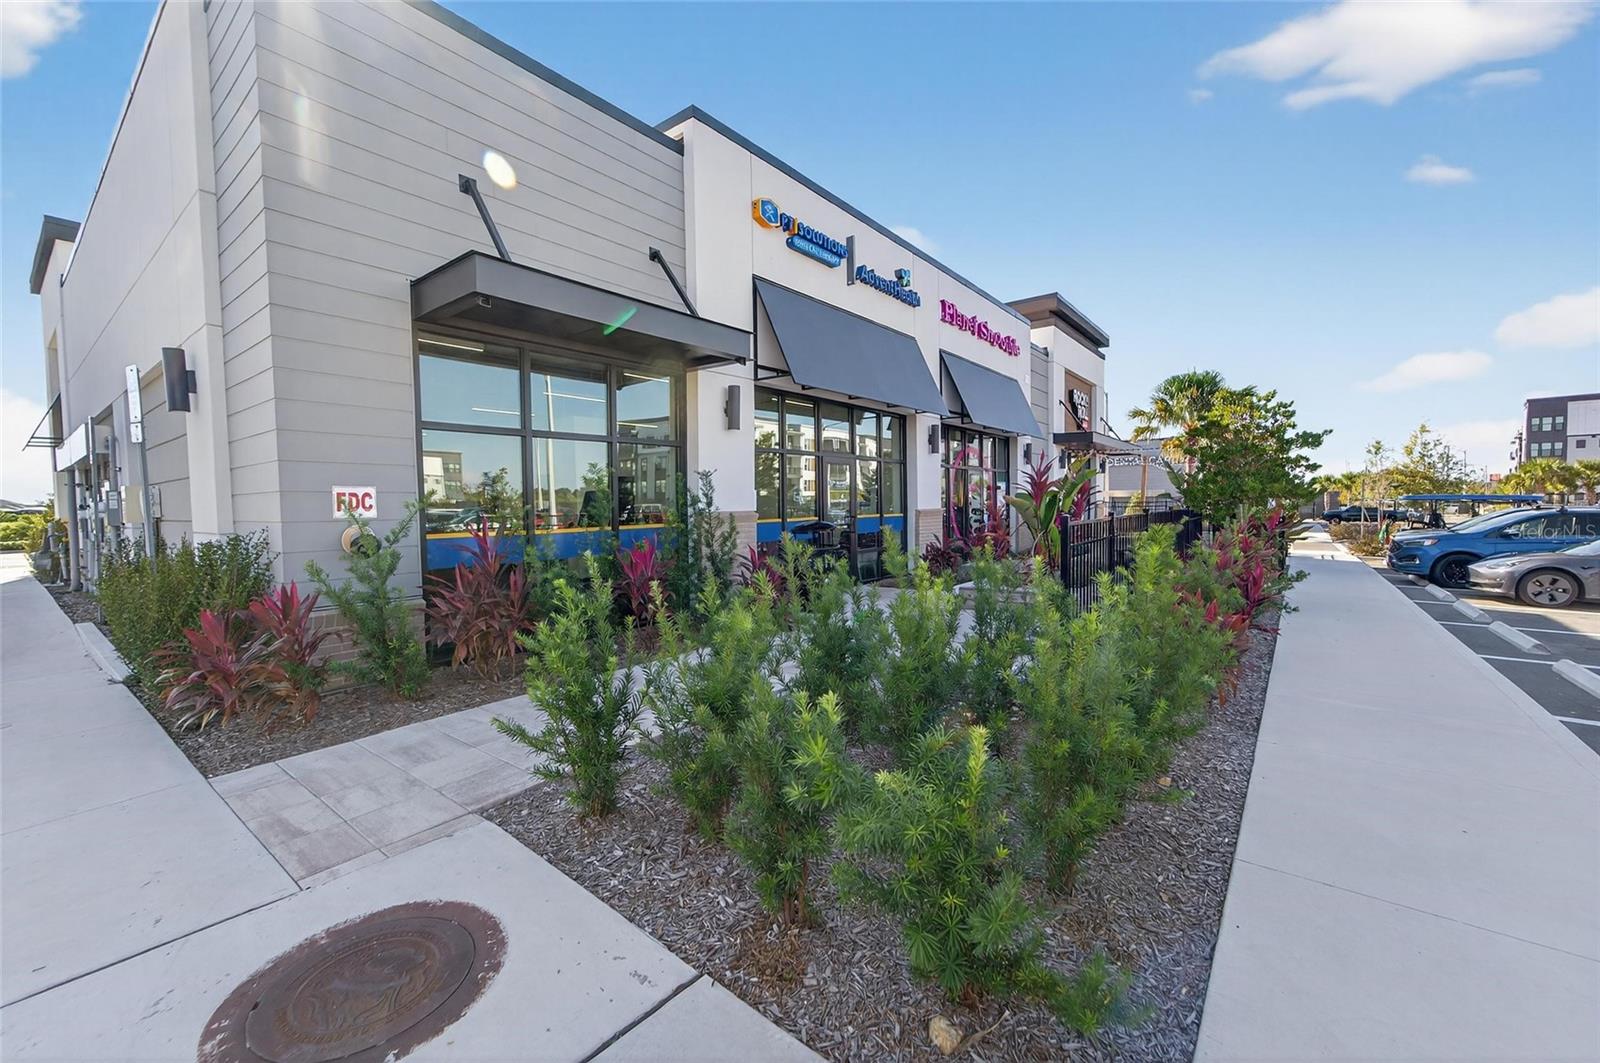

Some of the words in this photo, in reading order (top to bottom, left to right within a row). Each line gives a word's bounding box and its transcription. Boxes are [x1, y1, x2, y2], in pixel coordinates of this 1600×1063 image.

[798, 222, 848, 258] SOLUTIONS
[940, 299, 977, 335] Planet
[336, 492, 373, 512] FDC
